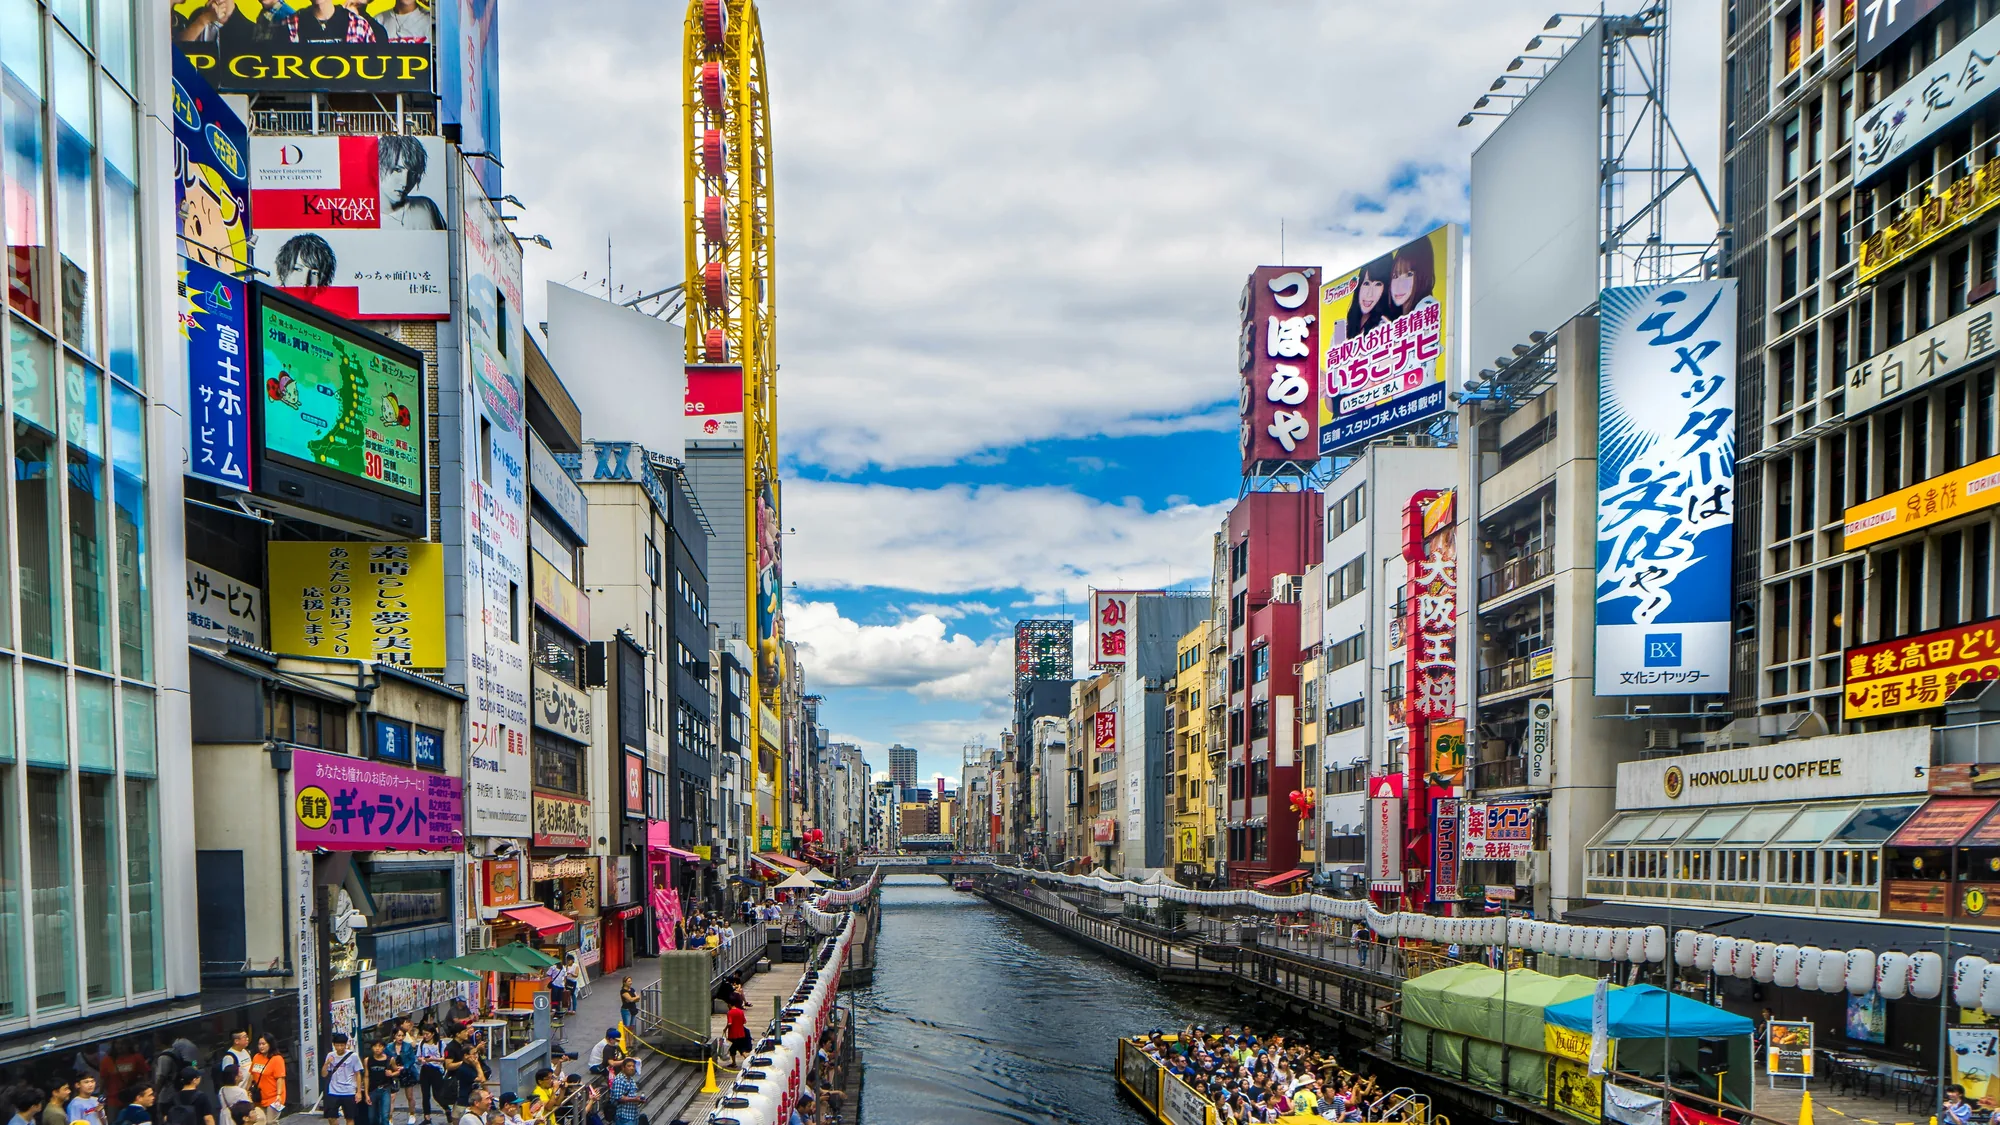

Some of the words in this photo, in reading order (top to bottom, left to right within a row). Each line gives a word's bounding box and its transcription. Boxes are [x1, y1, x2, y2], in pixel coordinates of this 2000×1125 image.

[228, 54, 429, 80] GROUP
[1919, 49, 1997, 123] 完全
[303, 194, 375, 215] KANZAKI
[330, 208, 375, 226] RUKA
[354, 270, 431, 281] めっちゃ面白いを
[408, 283, 442, 294] 仕事に。
[1327, 303, 1439, 369] 高収入お仕事情報
[1268, 267, 1316, 453] づぼらや
[1326, 326, 1439, 396] いちごナビ
[1881, 310, 1996, 399] 白木屋
[1850, 364, 1873, 391] 4F
[217, 324, 243, 480] 富士ホーム
[1342, 386, 1380, 410] いちごナビ
[1382, 381, 1399, 396] 求人
[199, 385, 216, 467] サービス
[365, 450, 383, 480] 30
[329, 547, 351, 656] あなたのお店づくり
[368, 545, 413, 667] 素晴らしい夢の実現
[302, 586, 325, 648] 応援します
[1415, 550, 1457, 717] 大阪王将
[1650, 642, 1676, 659] BX
[1871, 674, 1941, 710] 酒場
[472, 721, 499, 749] コスパ
[1097, 717, 1105, 743] ドラッグ
[1104, 713, 1114, 737] ツルハ
[1533, 721, 1546, 754] ZERO
[385, 726, 395, 754] 酒
[415, 733, 435, 760] たばこ
[315, 763, 426, 792] あなたも憧れのお店のオーナーに!
[1533, 754, 1543, 778] cafe
[1688, 765, 1770, 788] HONOLULU
[1773, 757, 1842, 781] COFFEE
[300, 795, 328, 820] 賃貸
[333, 787, 428, 837] ギャラント
[1467, 805, 1485, 838] 薬
[1488, 807, 1531, 828] ダイコク
[329, 823, 337, 836] の
[1439, 819, 1454, 862] ダイコク
[1484, 841, 1511, 859] 免税
[1436, 886, 1456, 895] 免税
